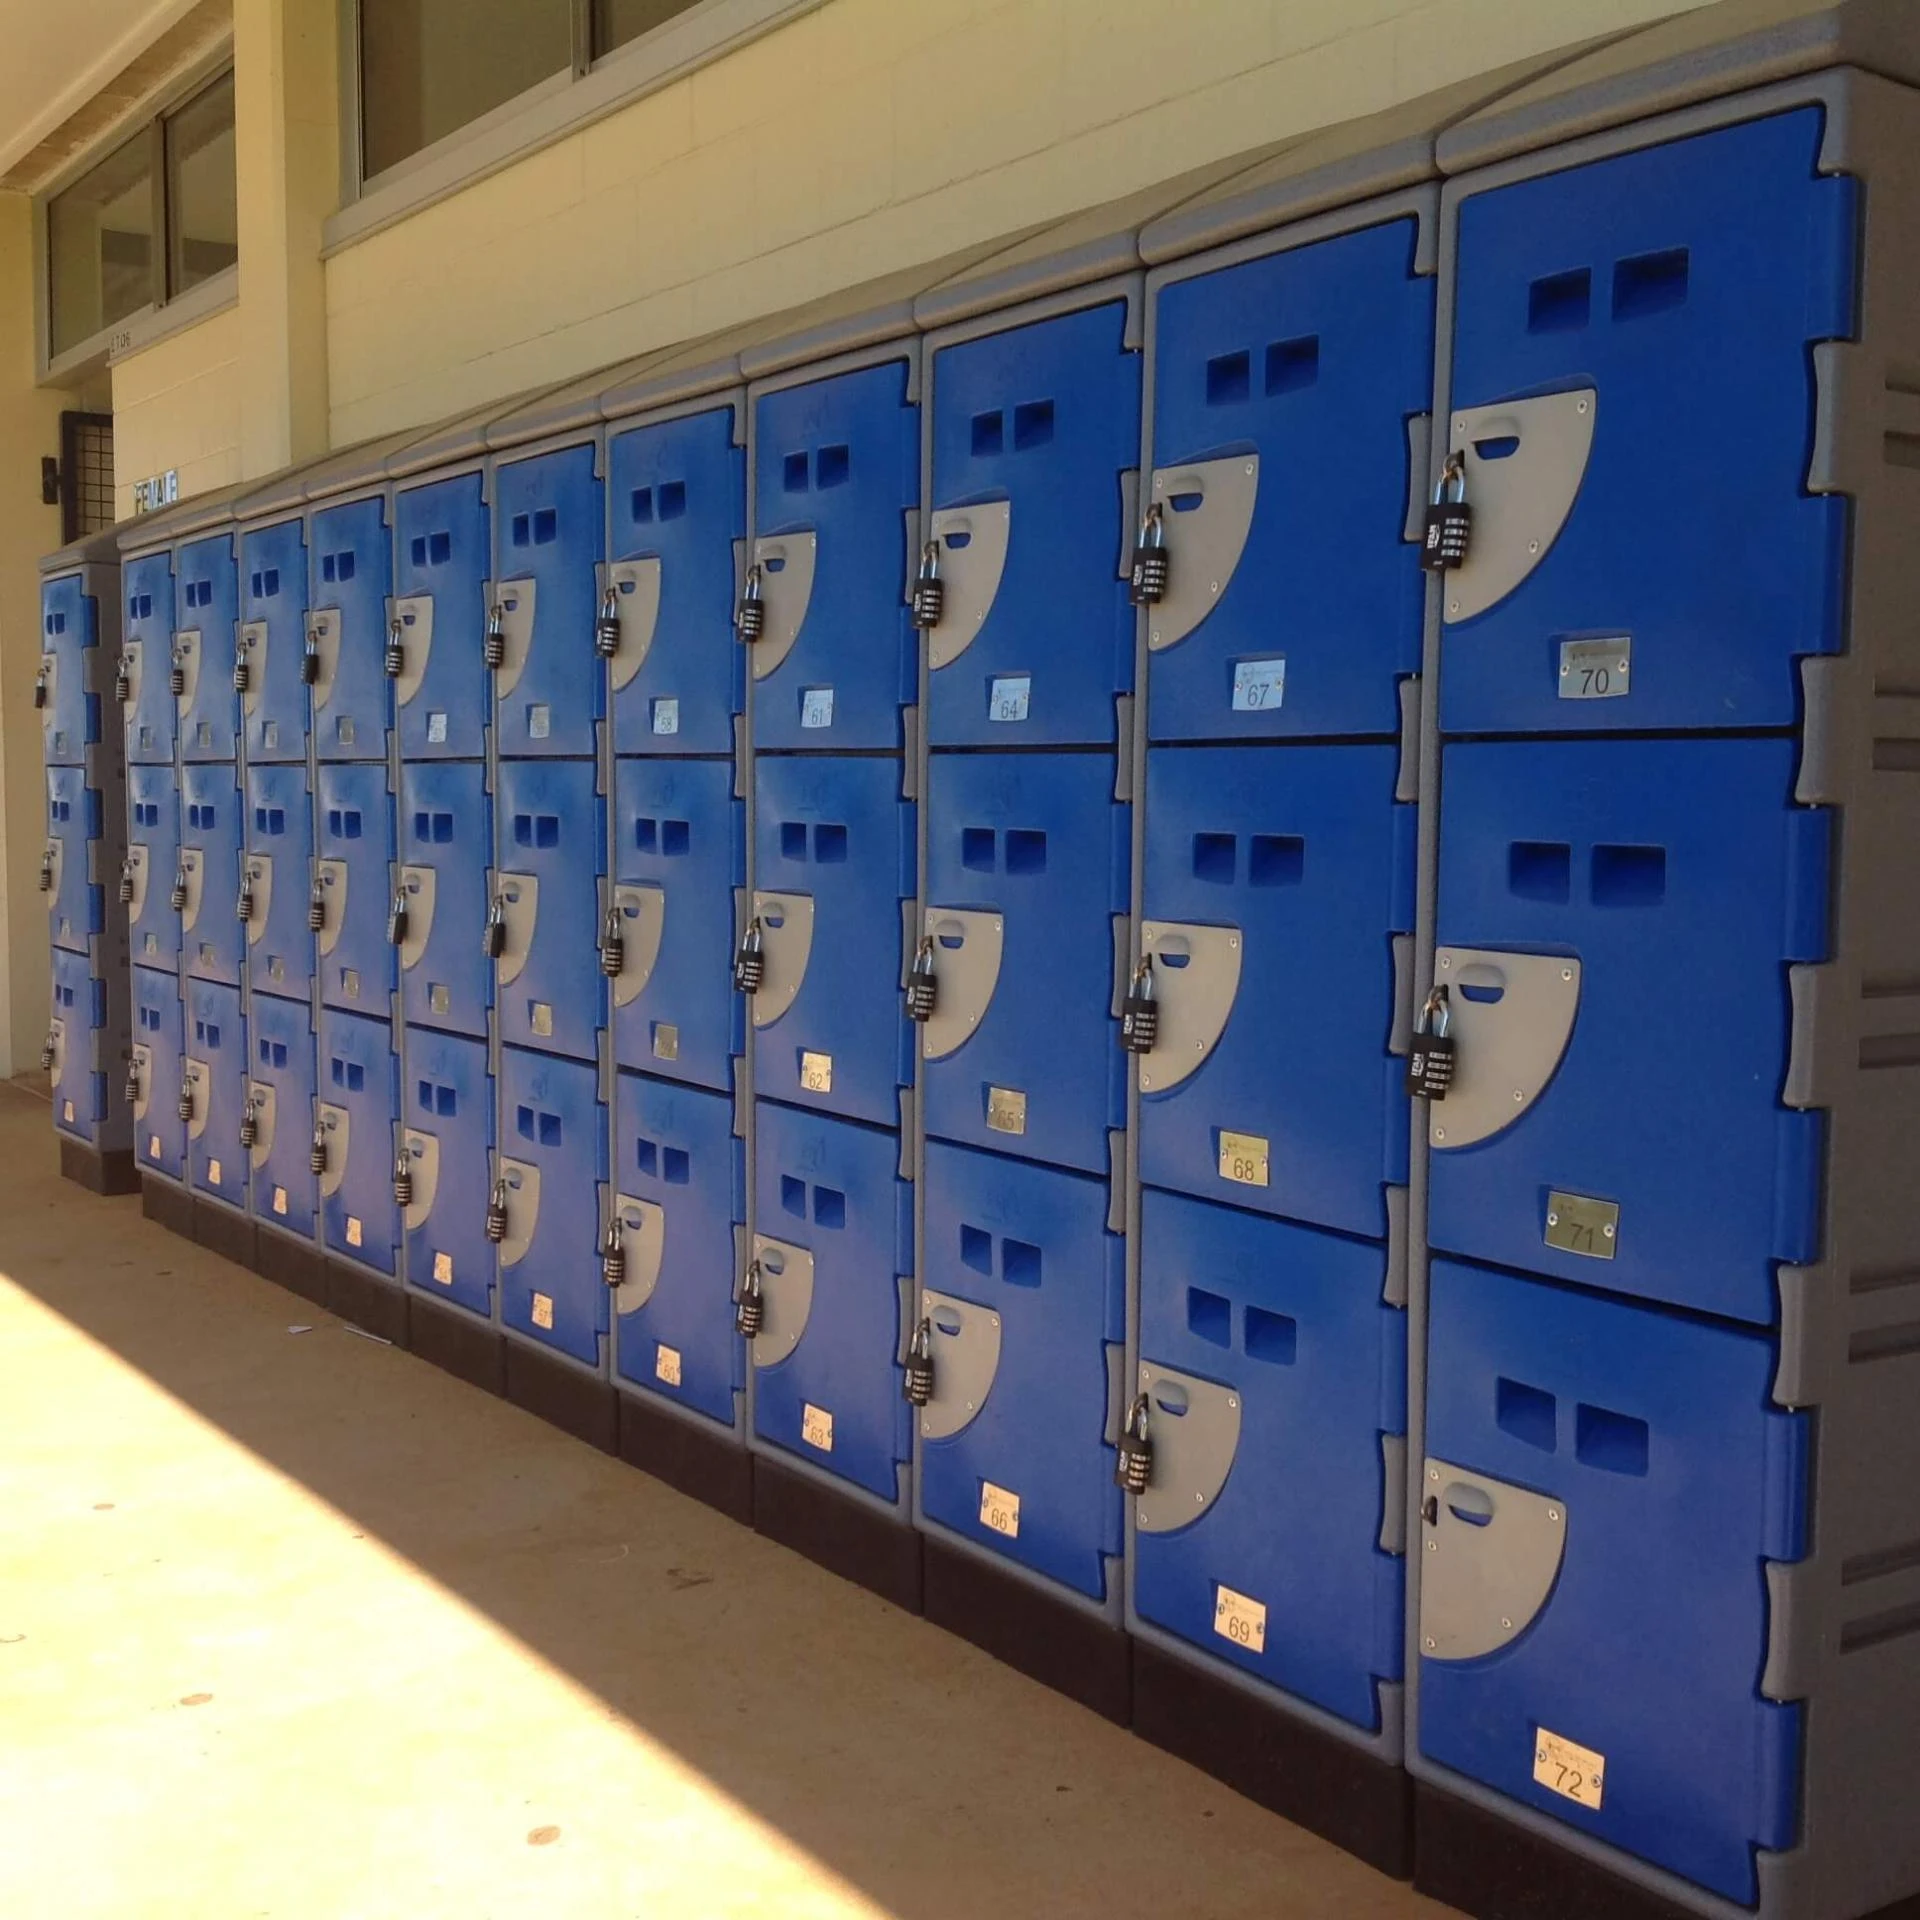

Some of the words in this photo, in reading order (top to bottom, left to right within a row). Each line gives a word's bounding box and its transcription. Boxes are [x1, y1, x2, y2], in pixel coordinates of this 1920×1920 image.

[1580, 668, 1609, 695] 70
[1247, 683, 1270, 707] 67
[811, 708, 823, 725] 61
[1000, 698, 1017, 719] 64
[809, 1072, 823, 1090] 62
[997, 1110, 1015, 1129] 65
[1233, 1157, 1255, 1181] 68
[1569, 1222, 1595, 1250] 71
[810, 1427, 824, 1446] 63
[990, 1508, 1007, 1530] 66
[1229, 1616, 1250, 1643] 69
[1555, 1761, 1583, 1798] 72
